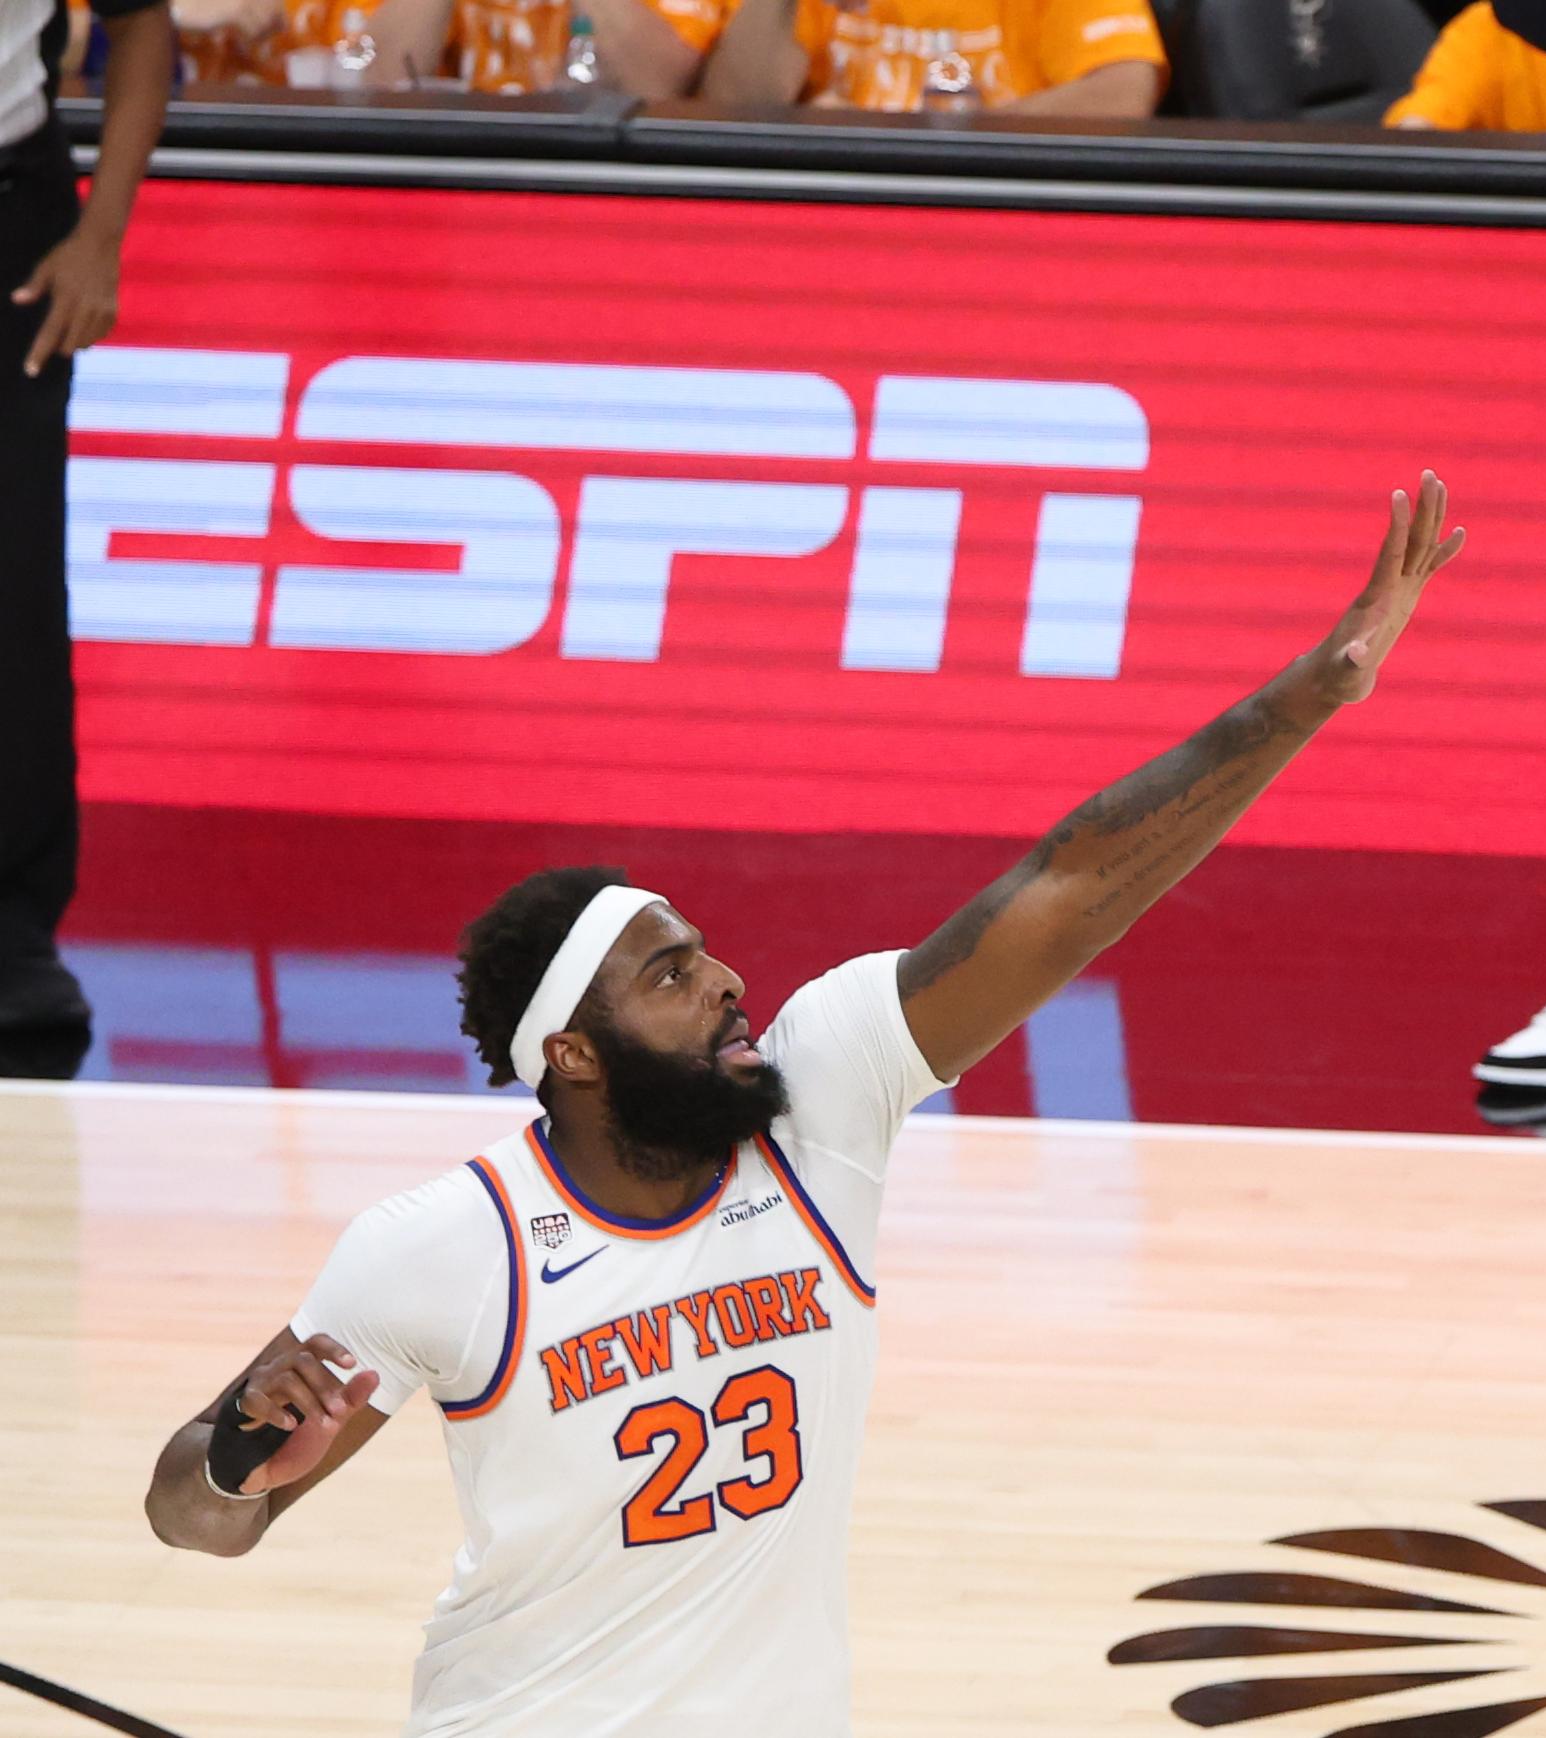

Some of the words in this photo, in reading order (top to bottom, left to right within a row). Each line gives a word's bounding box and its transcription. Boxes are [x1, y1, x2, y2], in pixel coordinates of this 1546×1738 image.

[65, 345, 1150, 680] ESPN
[538, 1304, 676, 1415] NEW
[675, 1266, 832, 1360] YORK
[613, 1364, 804, 1549] 23
